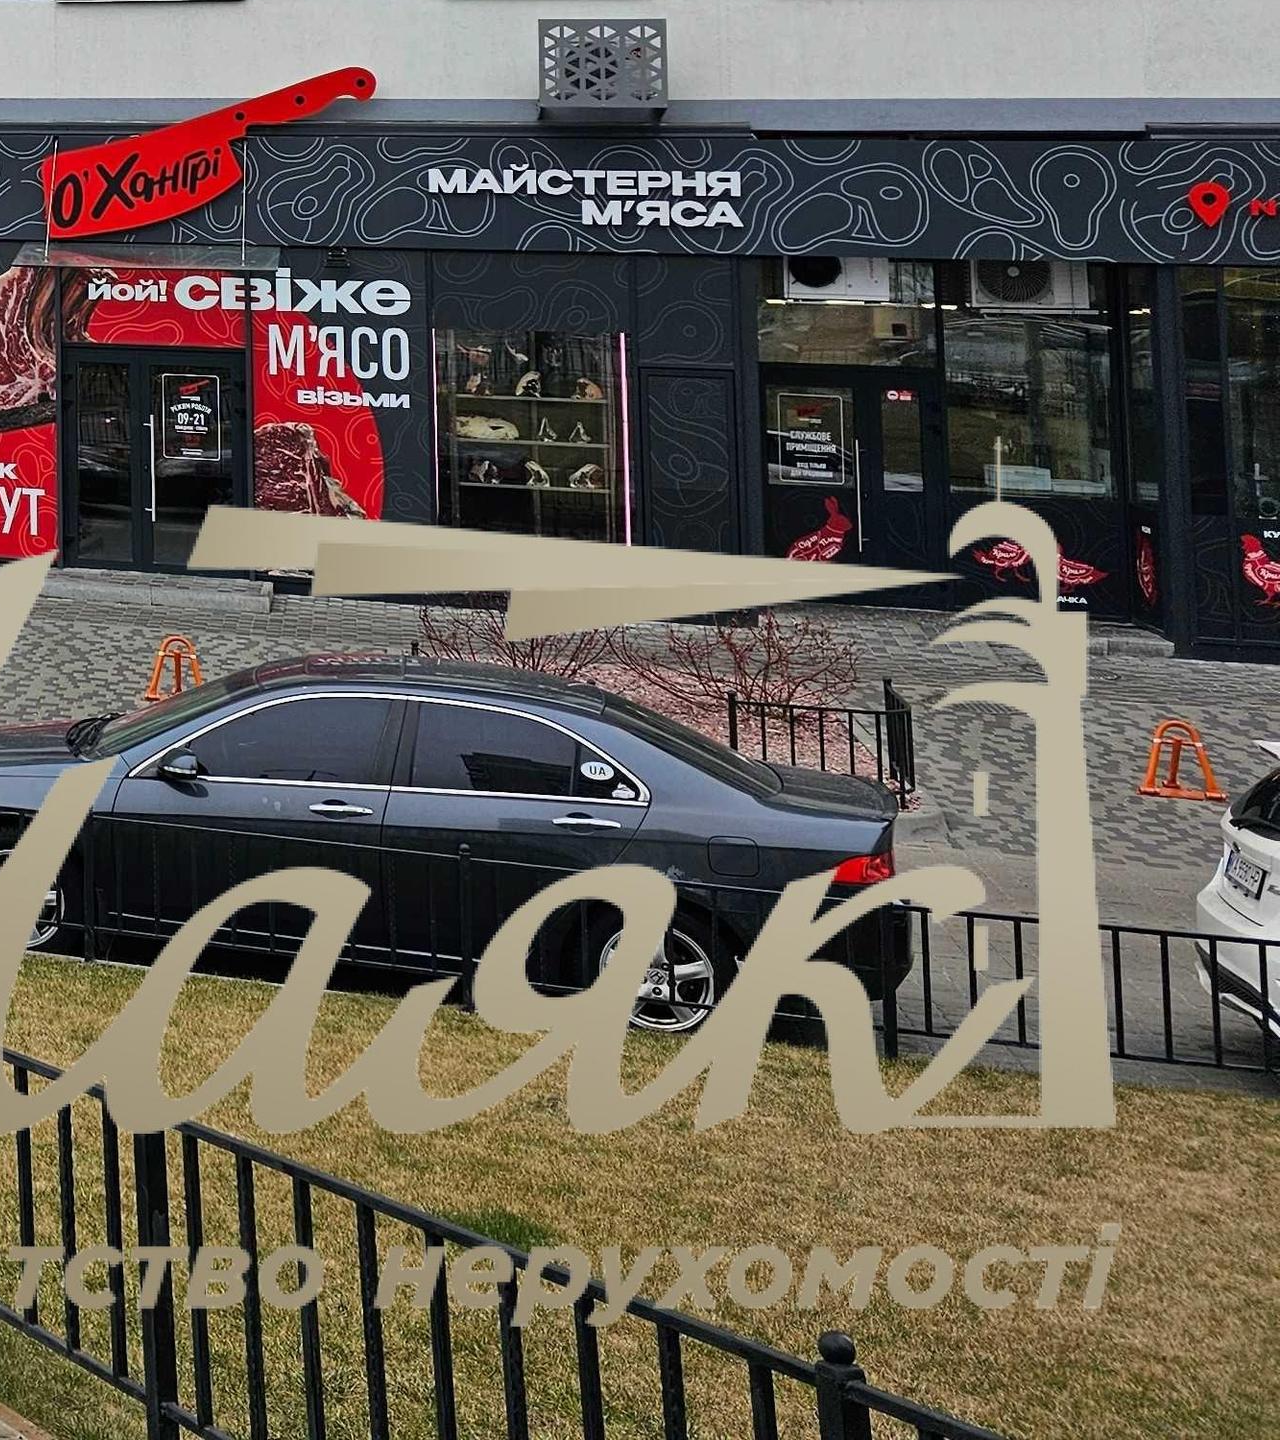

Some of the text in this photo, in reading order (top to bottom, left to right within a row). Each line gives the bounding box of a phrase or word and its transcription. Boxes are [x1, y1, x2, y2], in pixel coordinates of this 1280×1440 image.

[427, 163, 742, 197] МАЙСТЕРНЯ
[296, 386, 411, 409] візьми
[177, 412, 205, 426] 09-21
[1056, 594, 1088, 605] АЧКА
[589, 765, 606, 777] UA
